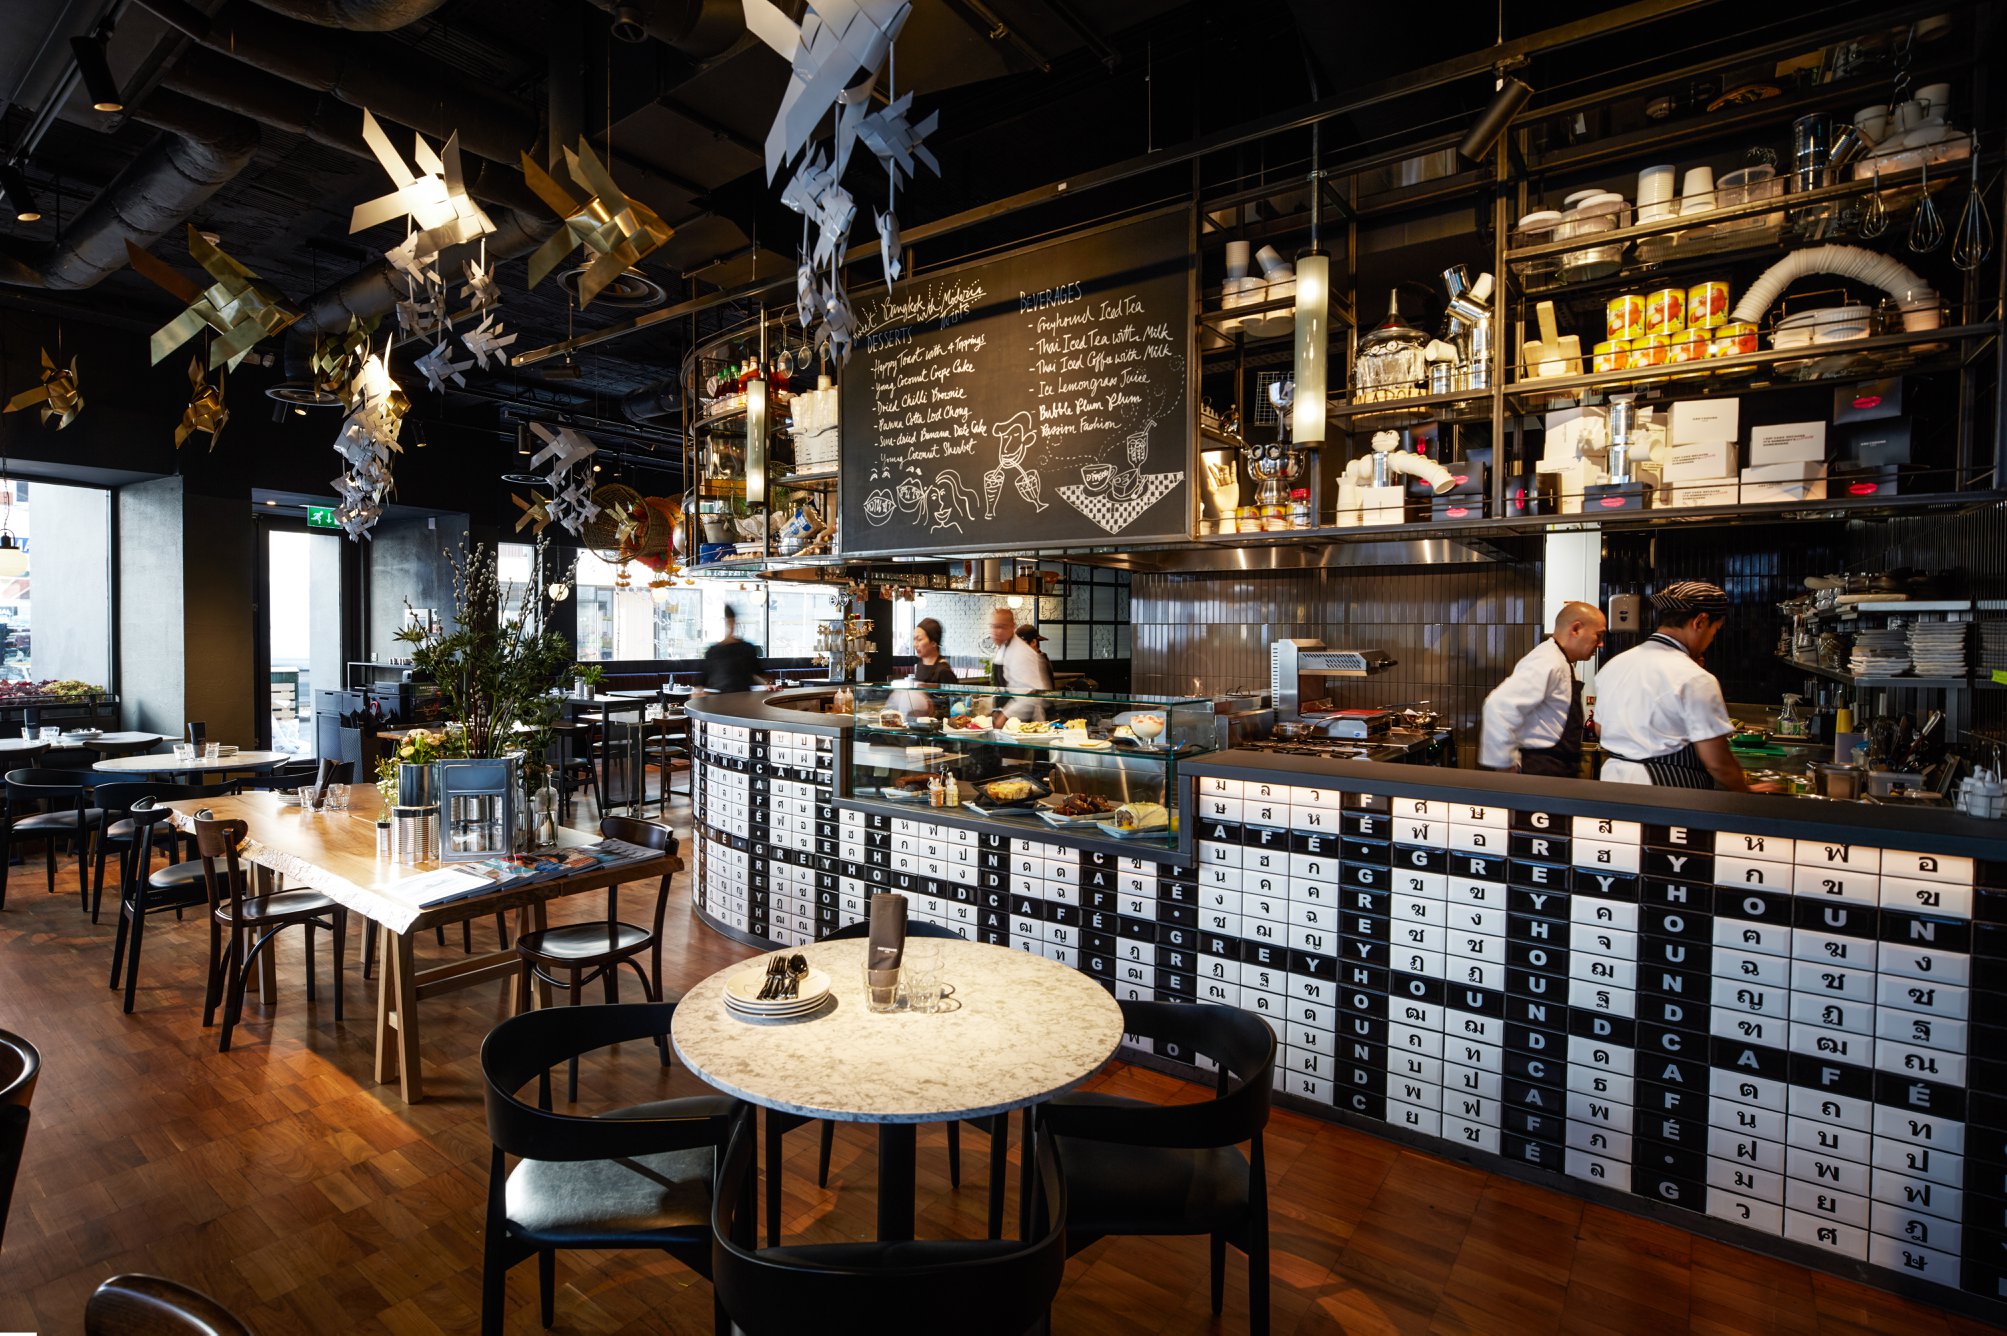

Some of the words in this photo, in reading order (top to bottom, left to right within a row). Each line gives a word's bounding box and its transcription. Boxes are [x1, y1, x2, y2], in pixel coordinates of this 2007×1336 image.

[881, 296, 926, 322] Bangkok
[916, 298, 941, 322] with
[1019, 280, 1082, 314] BEVERAGES
[1036, 305, 1095, 336] Greyhound
[1098, 299, 1123, 321] Iced
[1123, 294, 1146, 316] Tea
[866, 326, 912, 353] DESSERTS
[1035, 337, 1062, 355] Thai
[1061, 333, 1088, 353] Iced
[1087, 328, 1110, 348] Tea
[1111, 324, 1142, 345] with
[1142, 322, 1174, 343] Milk
[897, 347, 925, 368] Toast
[925, 344, 947, 361] with
[947, 342, 955, 353] 4
[1035, 359, 1057, 375] Thai
[1059, 354, 1086, 373] Iced
[1086, 350, 1114, 373] Coffee
[1113, 348, 1141, 365] with
[1142, 343, 1173, 361] Milk
[896, 369, 929, 388] Coconut
[930, 365, 951, 383] Crepe
[952, 359, 976, 373] Cake
[1037, 381, 1056, 398] Ice
[1058, 376, 1119, 397] Lemongrass
[1119, 366, 1152, 388] Juice
[877, 400, 901, 415] Dried
[901, 389, 928, 407] Chilli
[931, 387, 967, 403] Brownie
[1038, 400, 1074, 421] Bubble
[1075, 397, 1105, 415] Plum
[1105, 391, 1144, 412] Plum
[878, 418, 904, 432] Panna
[905, 412, 926, 426] Cotta
[943, 405, 973, 422] Chong
[920, 427, 952, 442] Banana
[953, 423, 971, 437] Date
[970, 418, 988, 436] Cake
[1040, 423, 1078, 438] Passion
[1079, 415, 1123, 434] Fashion
[907, 446, 941, 461] Coconut
[942, 437, 978, 456] Sherbet
